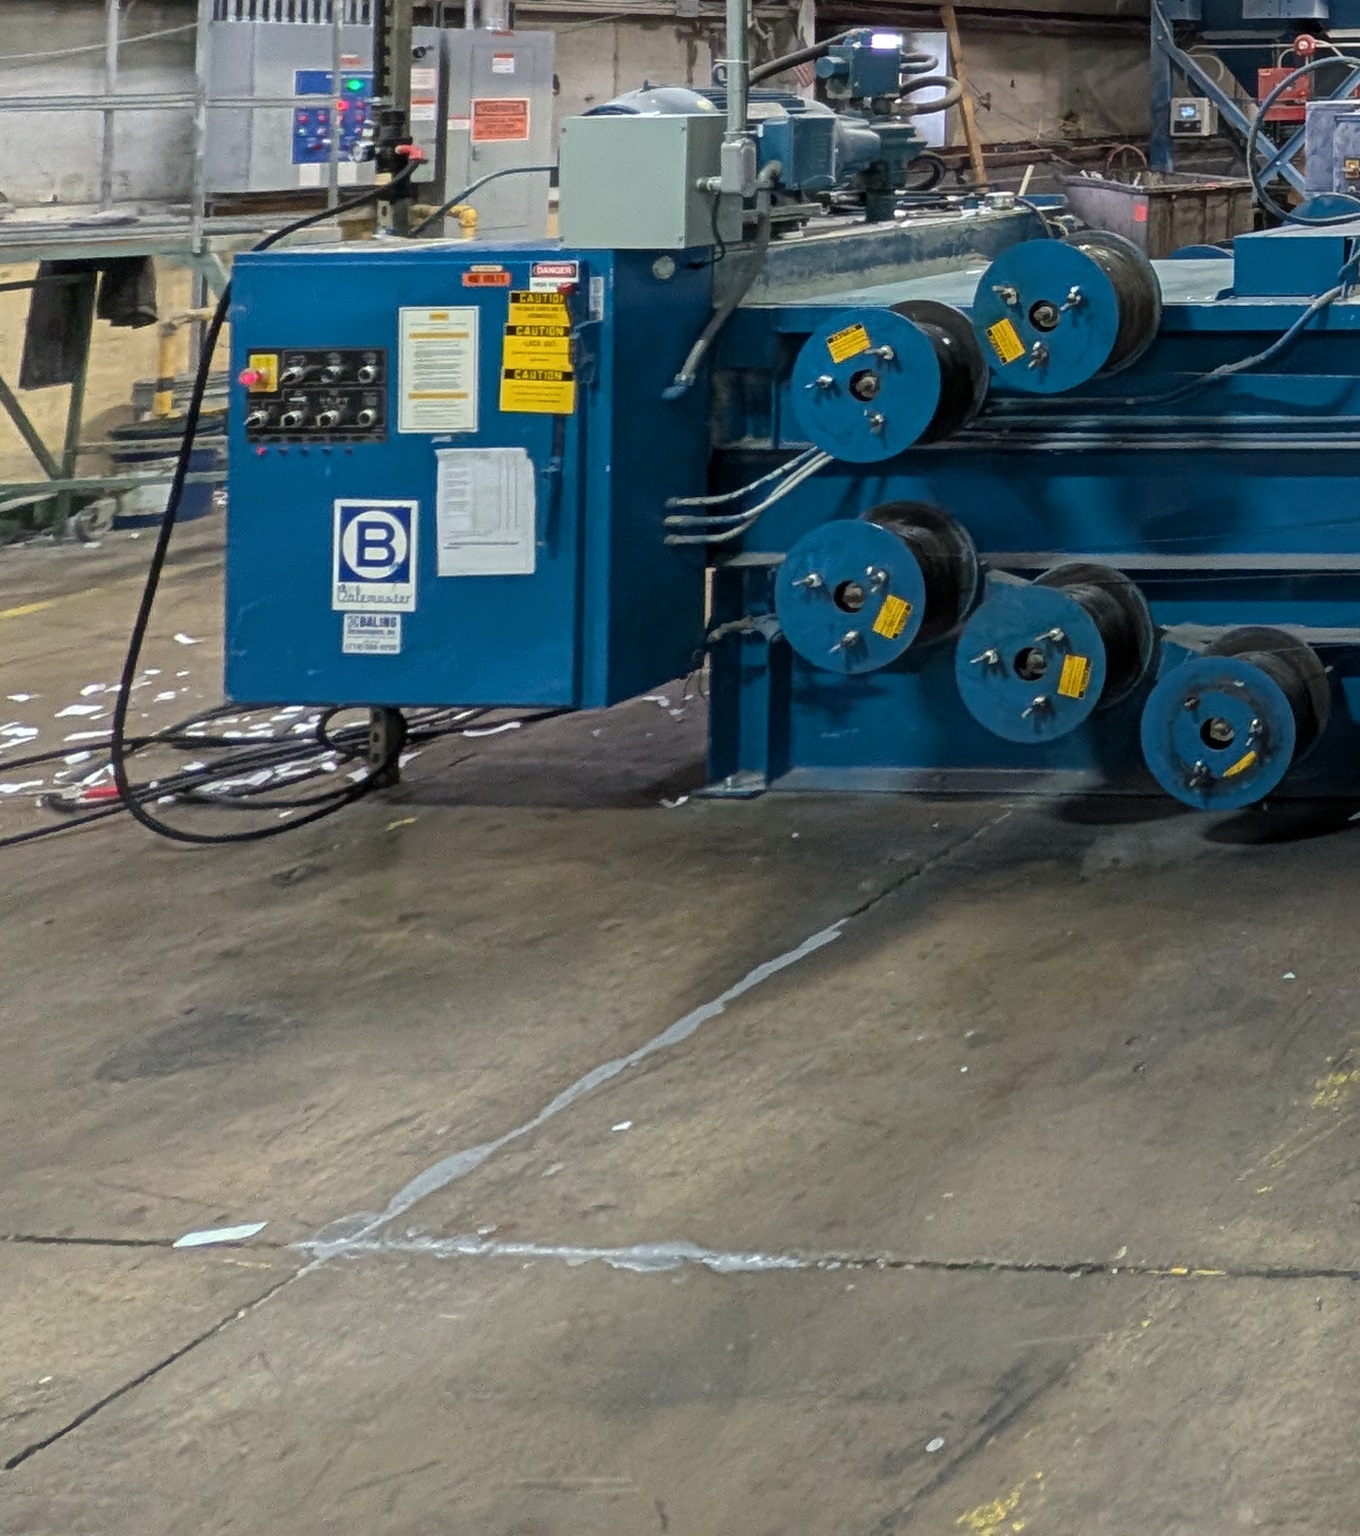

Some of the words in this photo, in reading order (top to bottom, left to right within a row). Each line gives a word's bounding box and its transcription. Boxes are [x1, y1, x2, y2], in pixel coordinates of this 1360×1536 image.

[535, 265, 572, 275] DANGER
[515, 325, 564, 336] CAUTION
[514, 369, 562, 380] CAUTION
[357, 521, 396, 567] B
[337, 584, 411, 603] Balemaster
